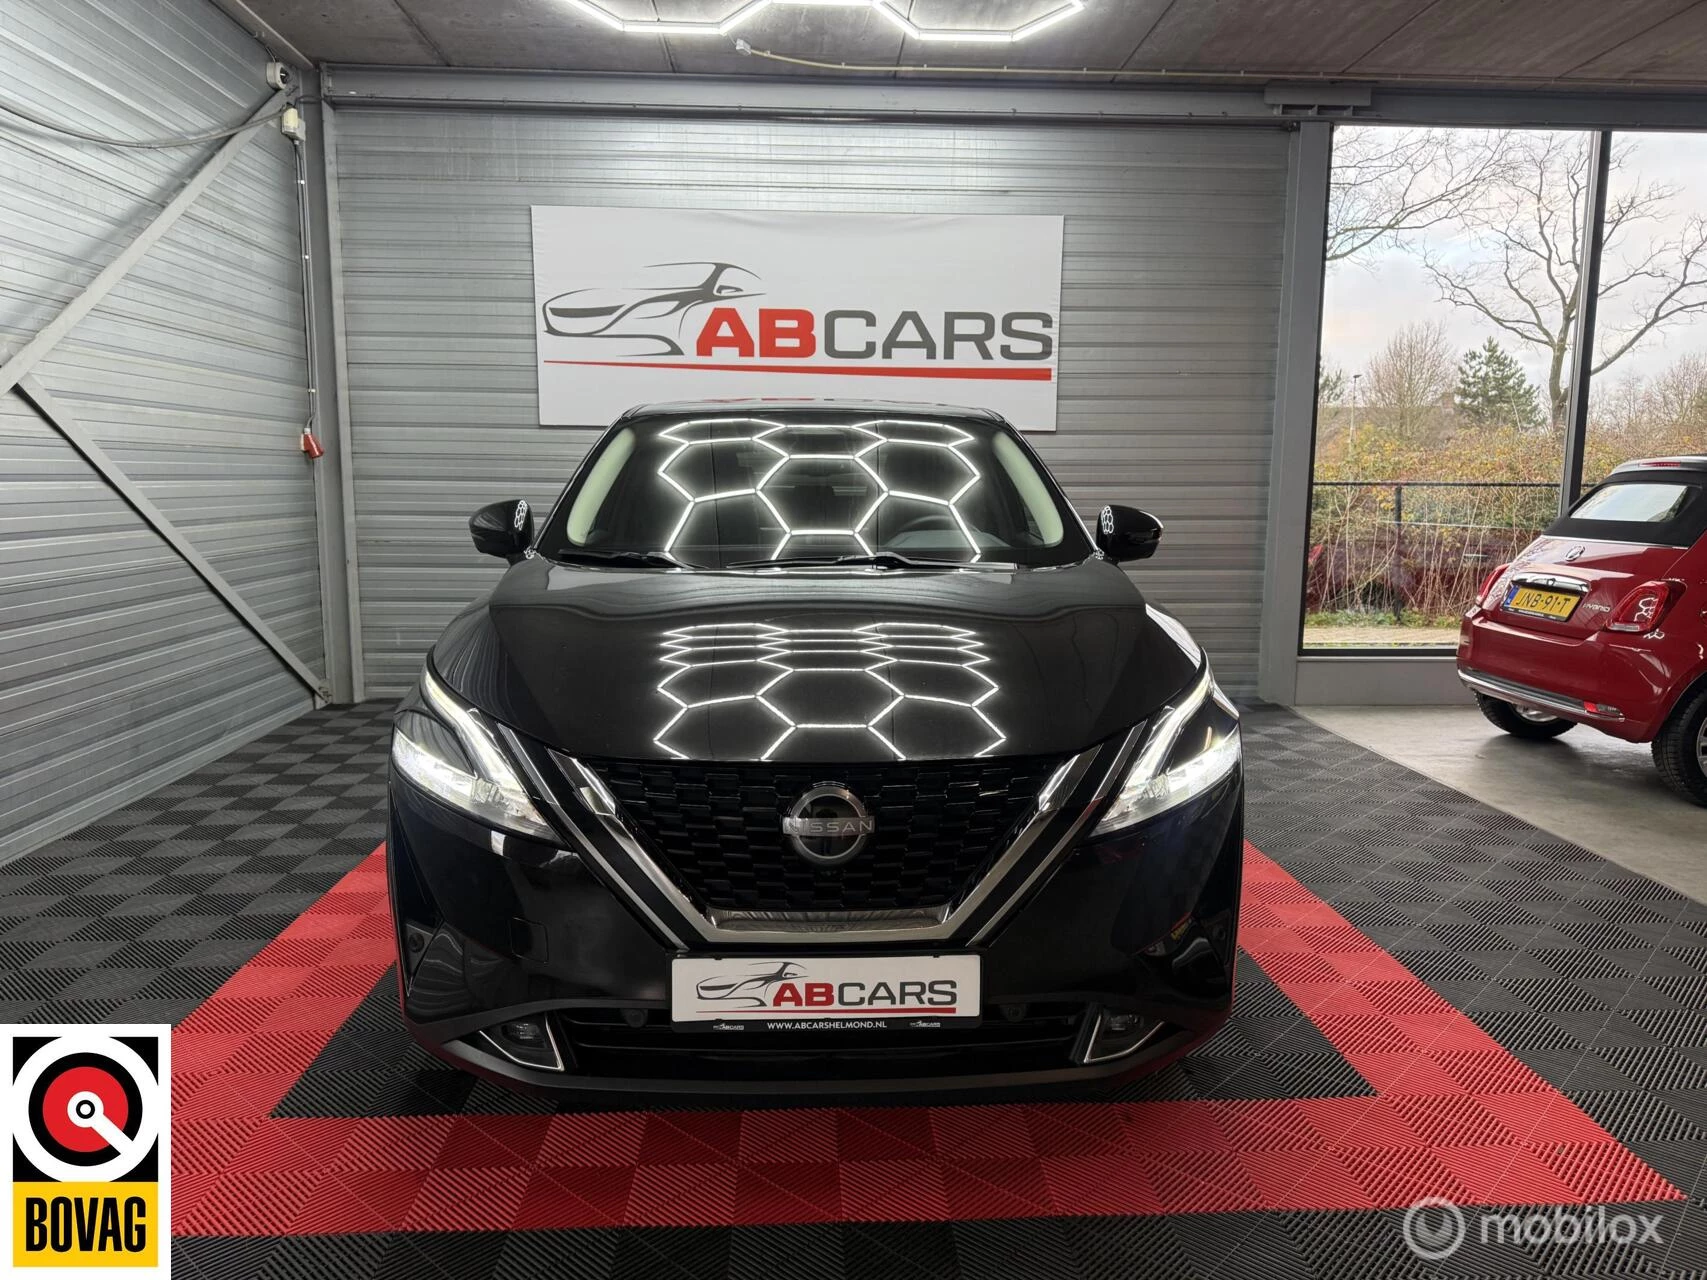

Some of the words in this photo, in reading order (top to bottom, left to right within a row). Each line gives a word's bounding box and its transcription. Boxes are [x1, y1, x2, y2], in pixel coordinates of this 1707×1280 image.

[696, 307, 1053, 360] ABCARS
[786, 820, 872, 834] NISSAN
[773, 980, 957, 1007] ABCARS
[767, 1020, 888, 1030] WWW.ABCARSHELMOND.NL
